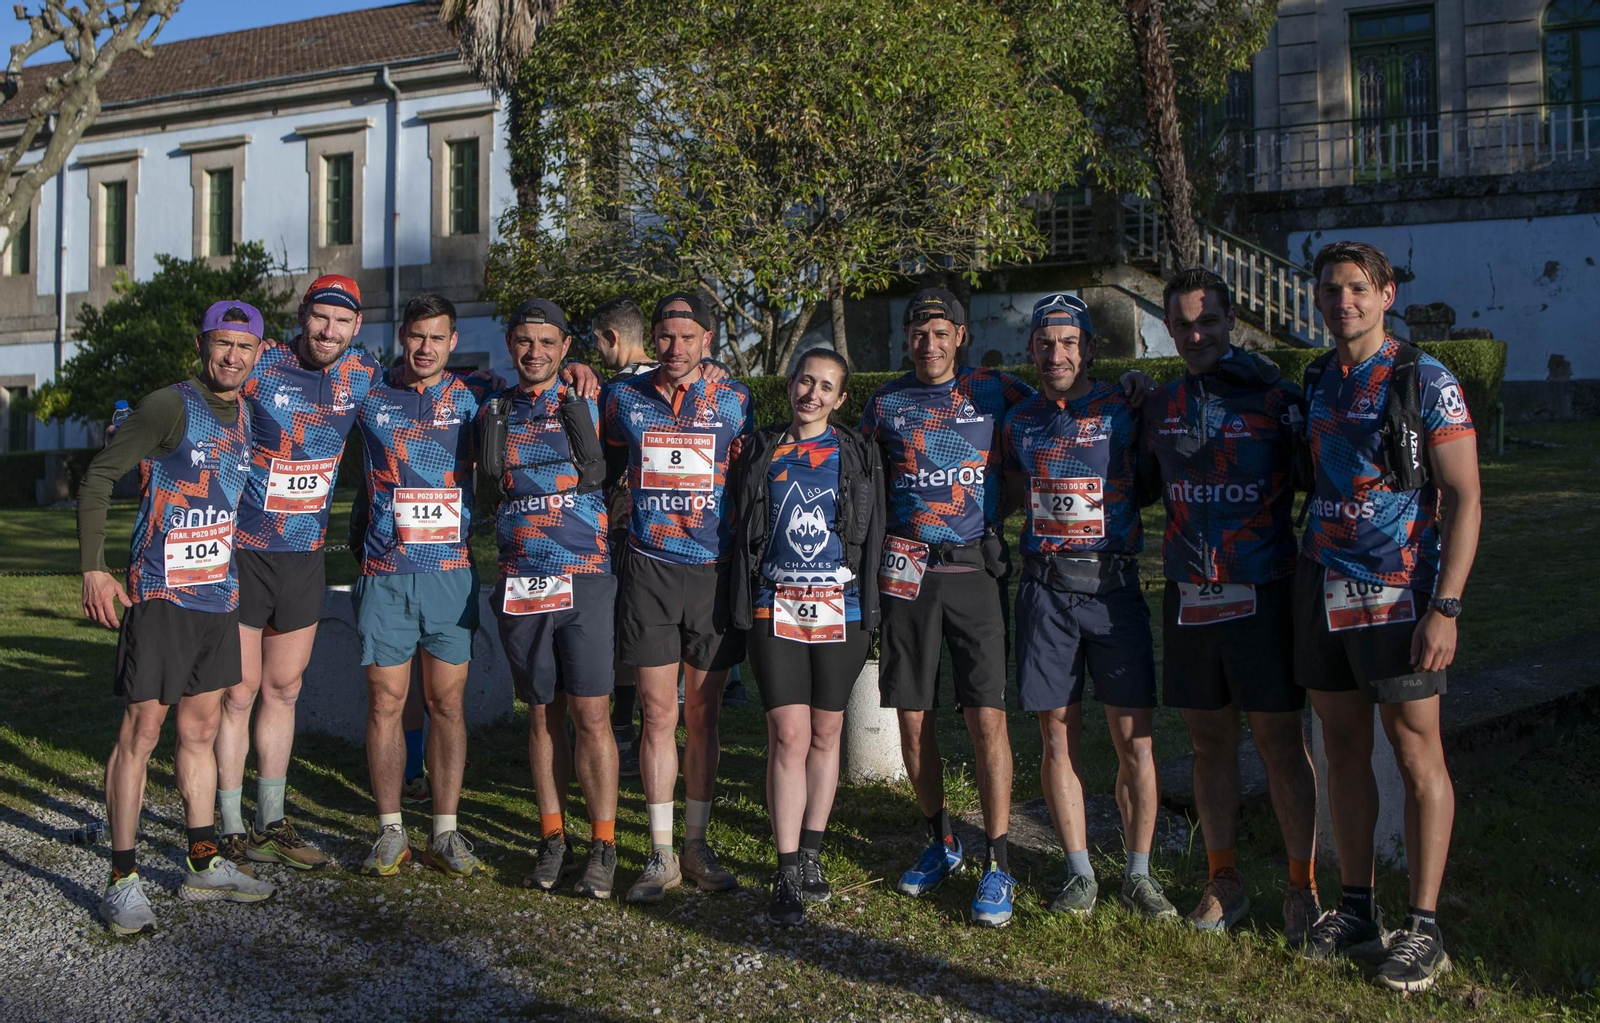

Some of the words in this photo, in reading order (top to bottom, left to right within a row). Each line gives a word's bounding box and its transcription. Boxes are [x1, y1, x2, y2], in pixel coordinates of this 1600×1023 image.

[671, 450, 682, 465] 8
[276, 463, 294, 471] TRAIL
[296, 463, 311, 471] POZO
[320, 462, 333, 470] DEMO
[287, 475, 318, 491] 103
[807, 487, 822, 499] do
[857, 483, 869, 539] KIPRUN
[1052, 496, 1074, 512] 29
[412, 505, 442, 519] 114
[170, 531, 190, 540] TRAIL
[191, 529, 209, 538] POZO
[210, 528, 218, 536] DO
[185, 542, 219, 560] 104
[881, 551, 907, 571] 100
[527, 577, 548, 591] 25
[798, 603, 818, 618] 61
[1403, 679, 1423, 688] FILA
